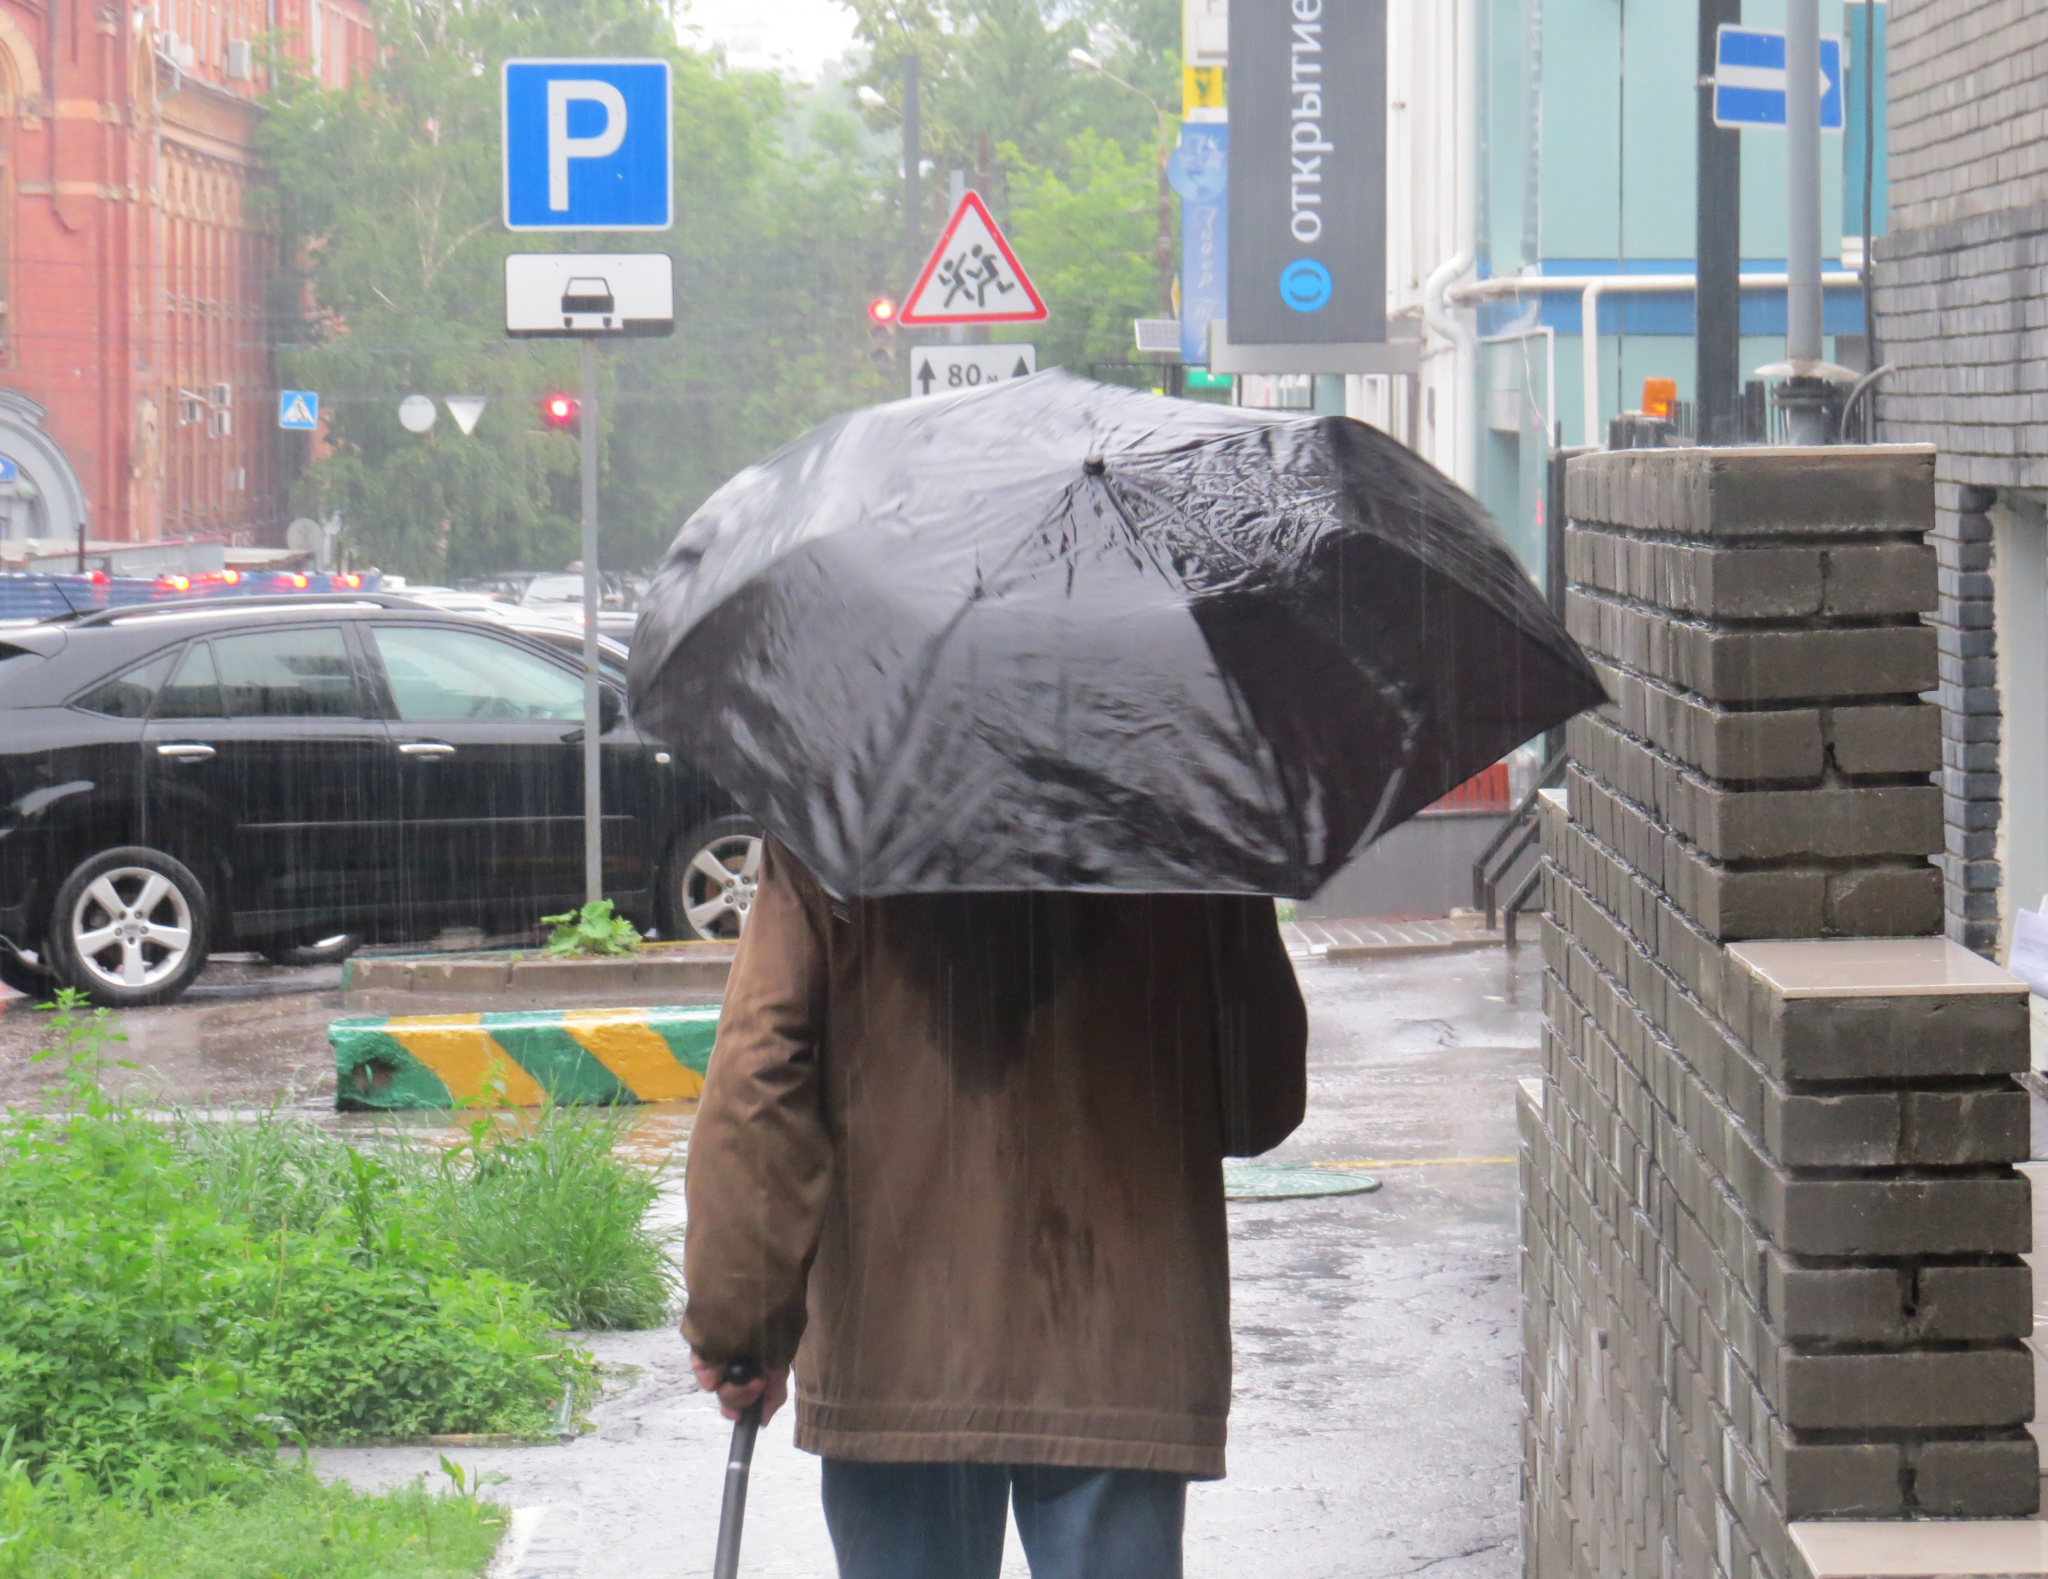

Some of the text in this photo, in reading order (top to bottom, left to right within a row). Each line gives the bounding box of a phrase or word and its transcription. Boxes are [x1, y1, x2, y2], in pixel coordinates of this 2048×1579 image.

[547, 79, 628, 211] P
[1291, 0, 1334, 243] открытие
[948, 363, 981, 387] 80
